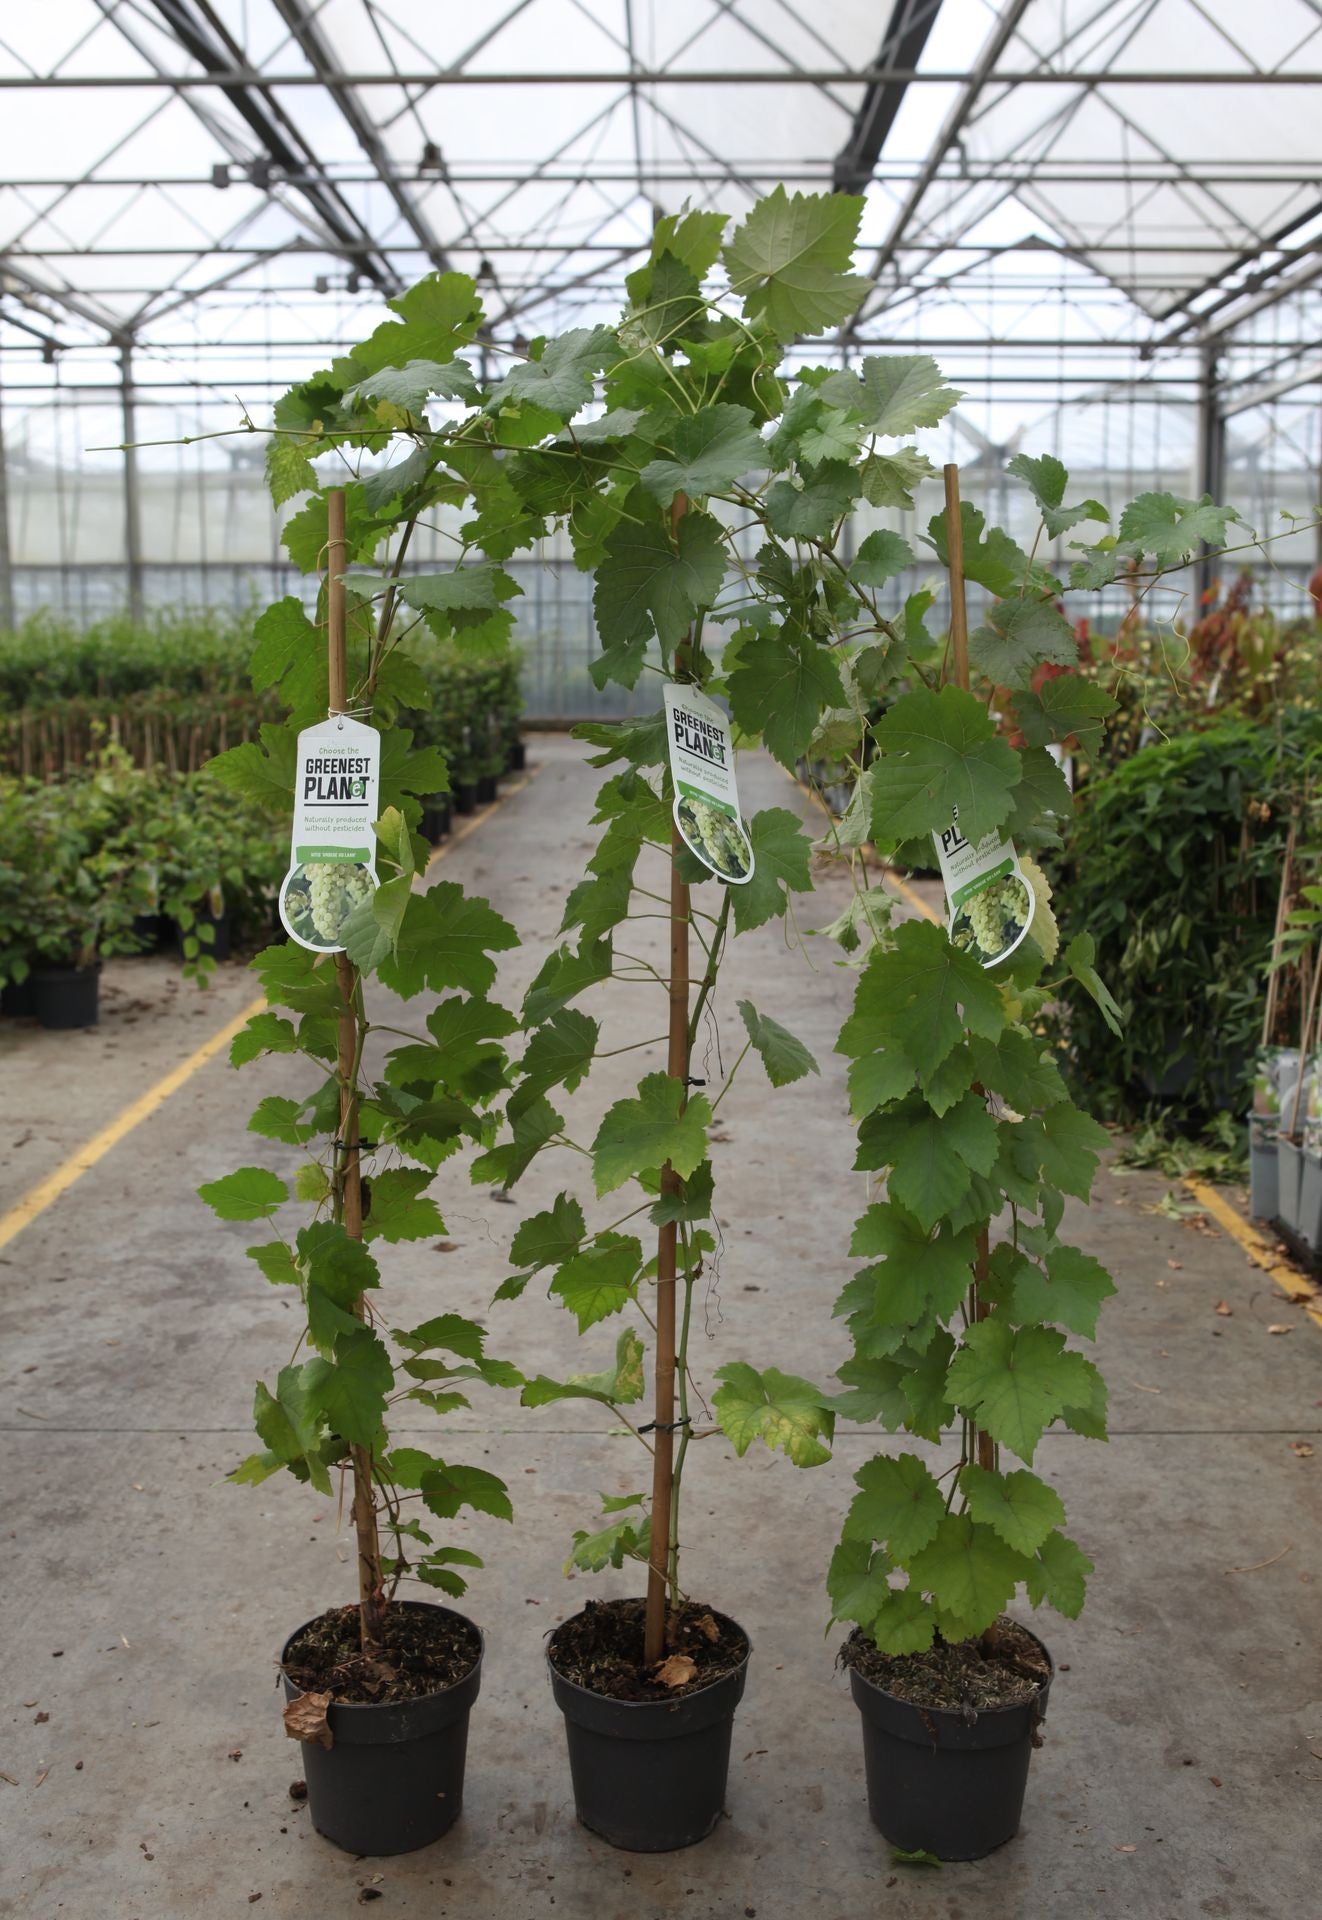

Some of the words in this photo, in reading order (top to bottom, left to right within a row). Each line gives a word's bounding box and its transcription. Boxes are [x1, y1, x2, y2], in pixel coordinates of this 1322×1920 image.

[673, 707, 725, 744] GREENEST
[318, 747, 346, 755] Choose
[305, 757, 371, 774] GREENEST
[304, 816, 334, 824] Naturally
[336, 816, 368, 824] produced
[333, 825, 365, 833] pesticides
